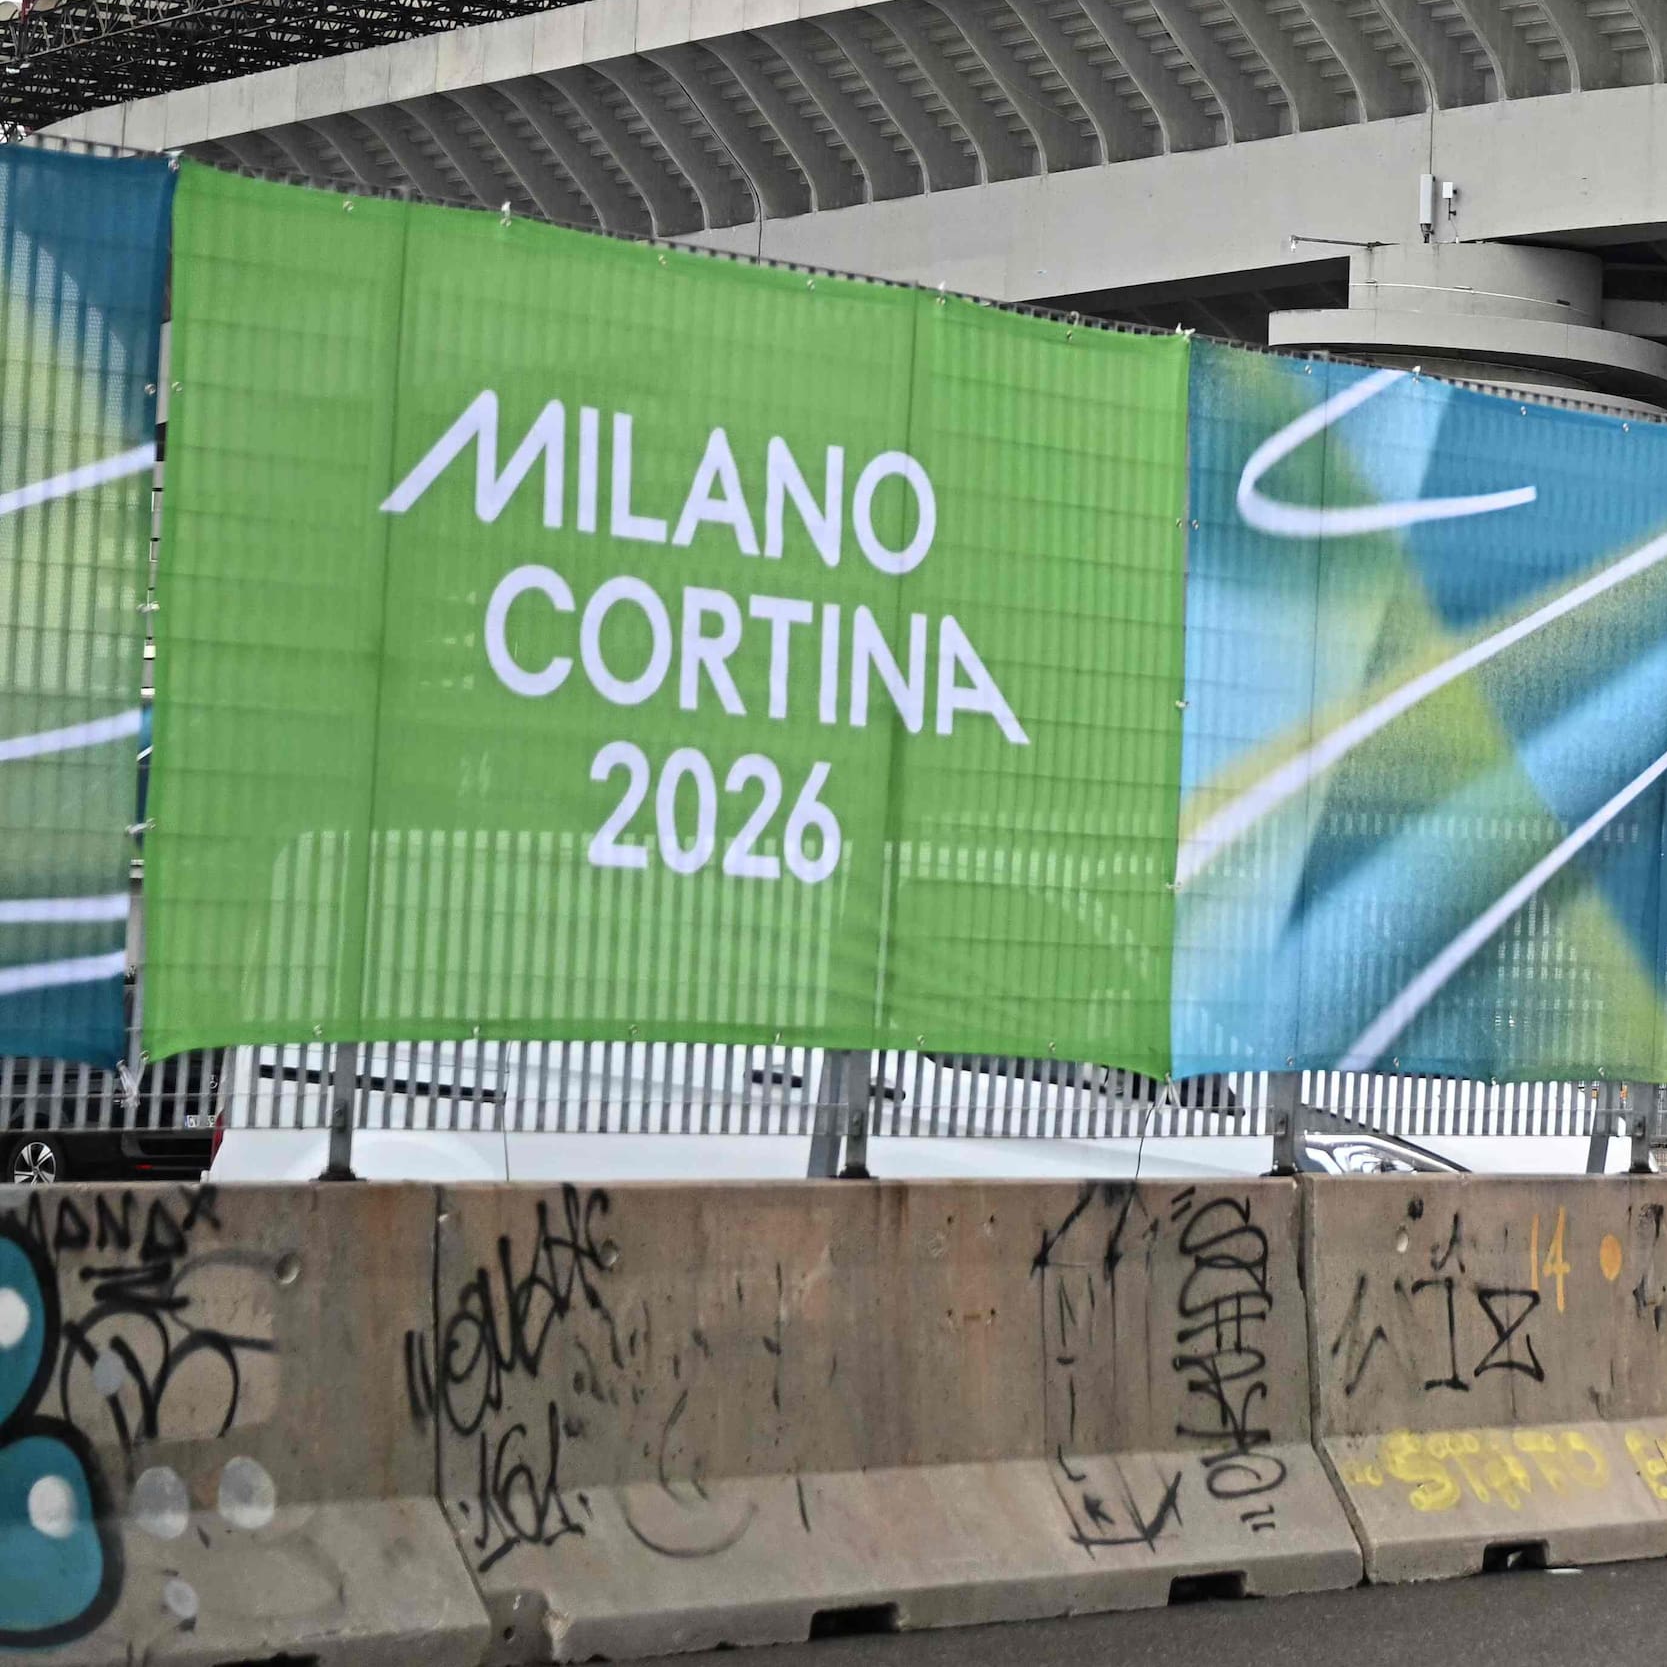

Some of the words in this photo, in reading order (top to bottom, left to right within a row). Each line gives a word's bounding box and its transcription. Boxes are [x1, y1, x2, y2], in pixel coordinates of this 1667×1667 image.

[379, 389, 937, 575] MILANO
[484, 564, 1031, 745] CORTINA
[588, 740, 842, 883] 2026
